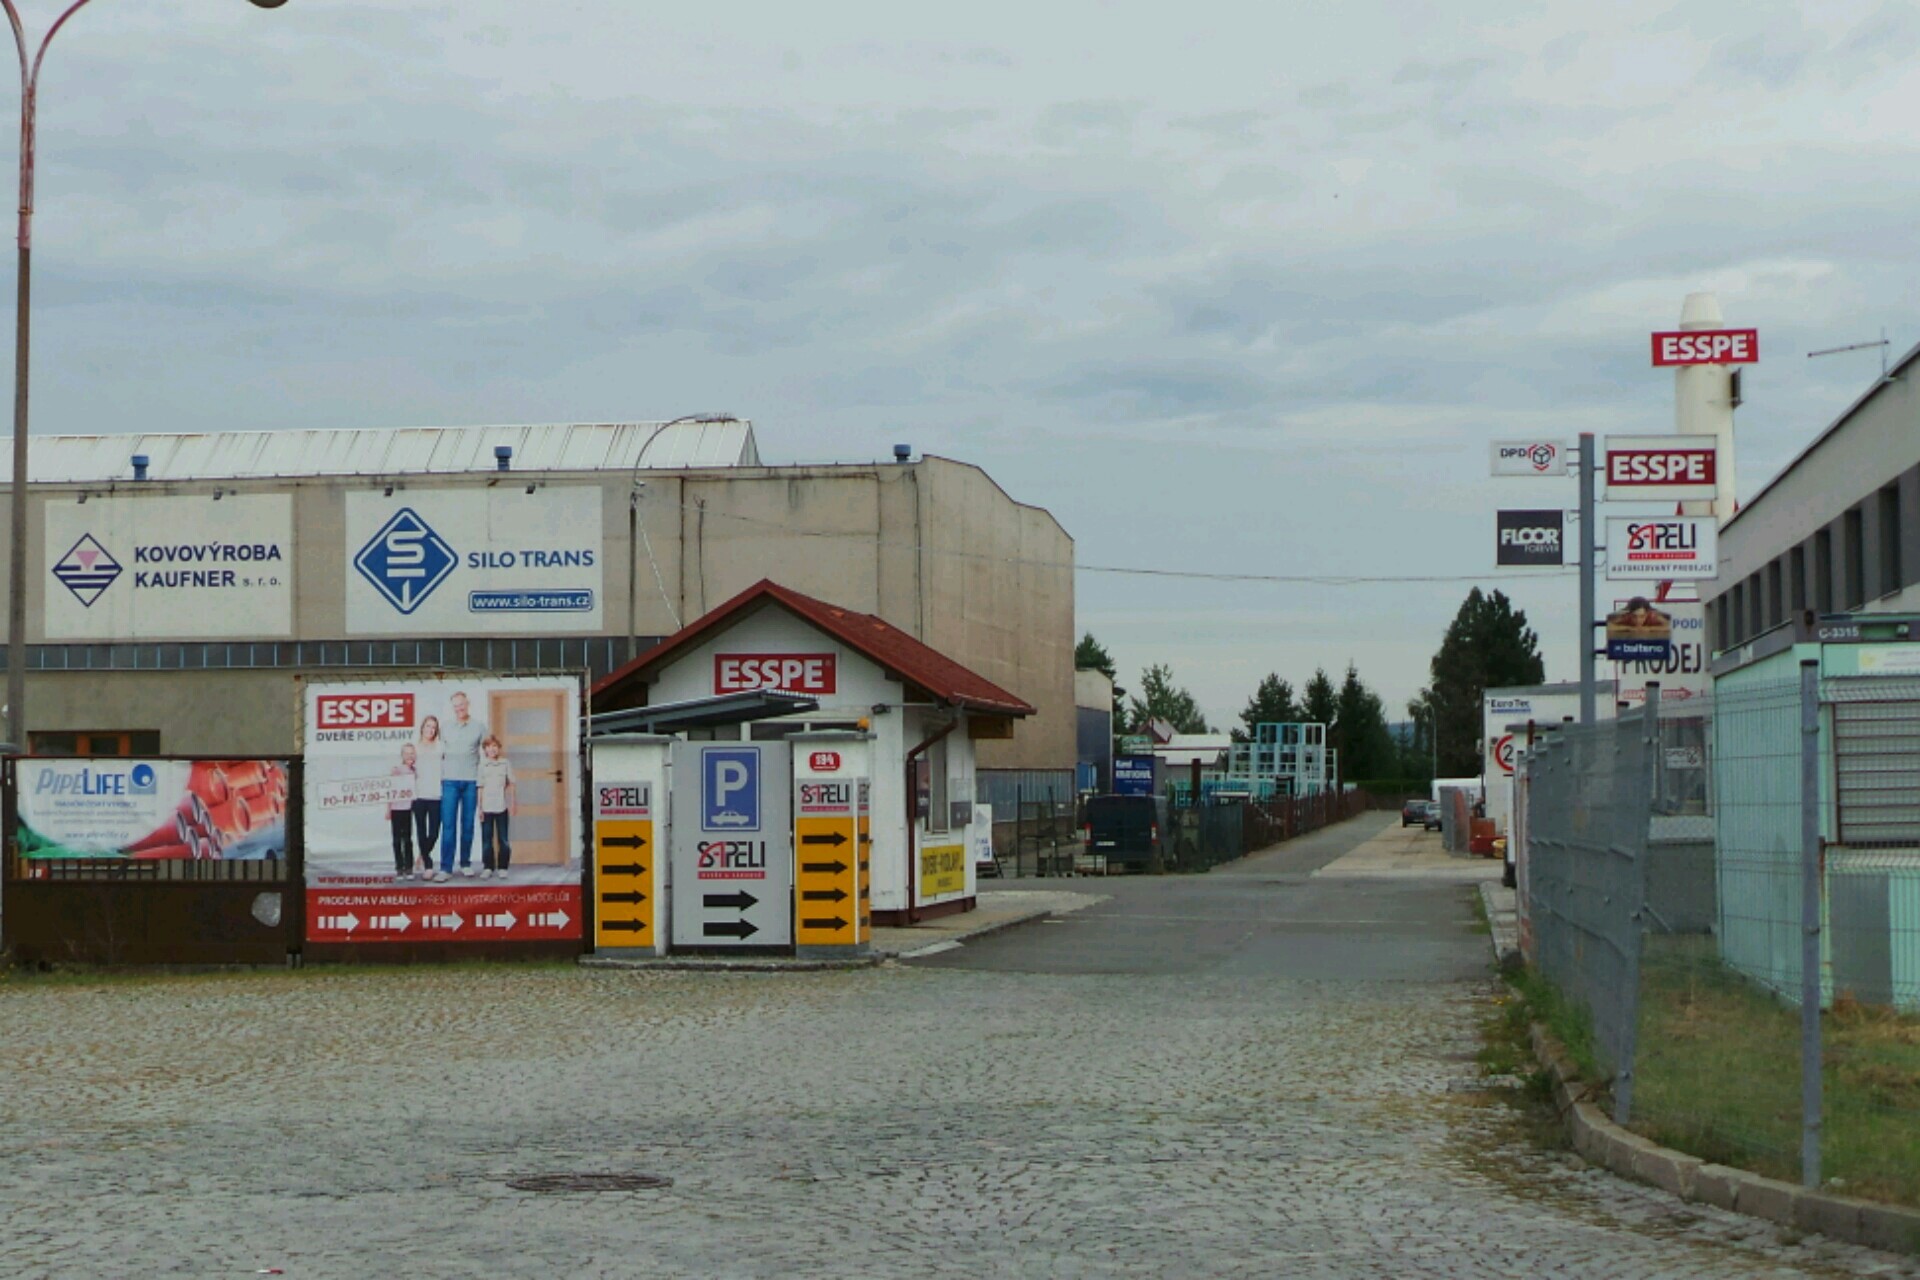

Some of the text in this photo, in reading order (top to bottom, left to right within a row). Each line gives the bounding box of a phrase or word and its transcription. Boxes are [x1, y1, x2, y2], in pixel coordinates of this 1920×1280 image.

[1663, 335, 1748, 360] ESSPE
[1500, 448, 1526, 458] DPD
[1613, 454, 1706, 481] ESSPE
[1501, 527, 1559, 546] FLOOR
[1627, 523, 1696, 550] SAPELI
[134, 541, 282, 563] KOVOVÝROBA
[467, 549, 594, 569] SILO TRANS
[134, 570, 236, 588] KAUFNER
[1818, 626, 1859, 639] C-3315
[720, 659, 825, 690] ESSPE
[322, 700, 404, 724] ESSPE
[316, 730, 414, 742] DVEŘE PODLAHY
[716, 760, 748, 807] P
[800, 784, 851, 804] SAPELI
[600, 787, 649, 807] SAPELI
[697, 841, 766, 868] SAPELI
